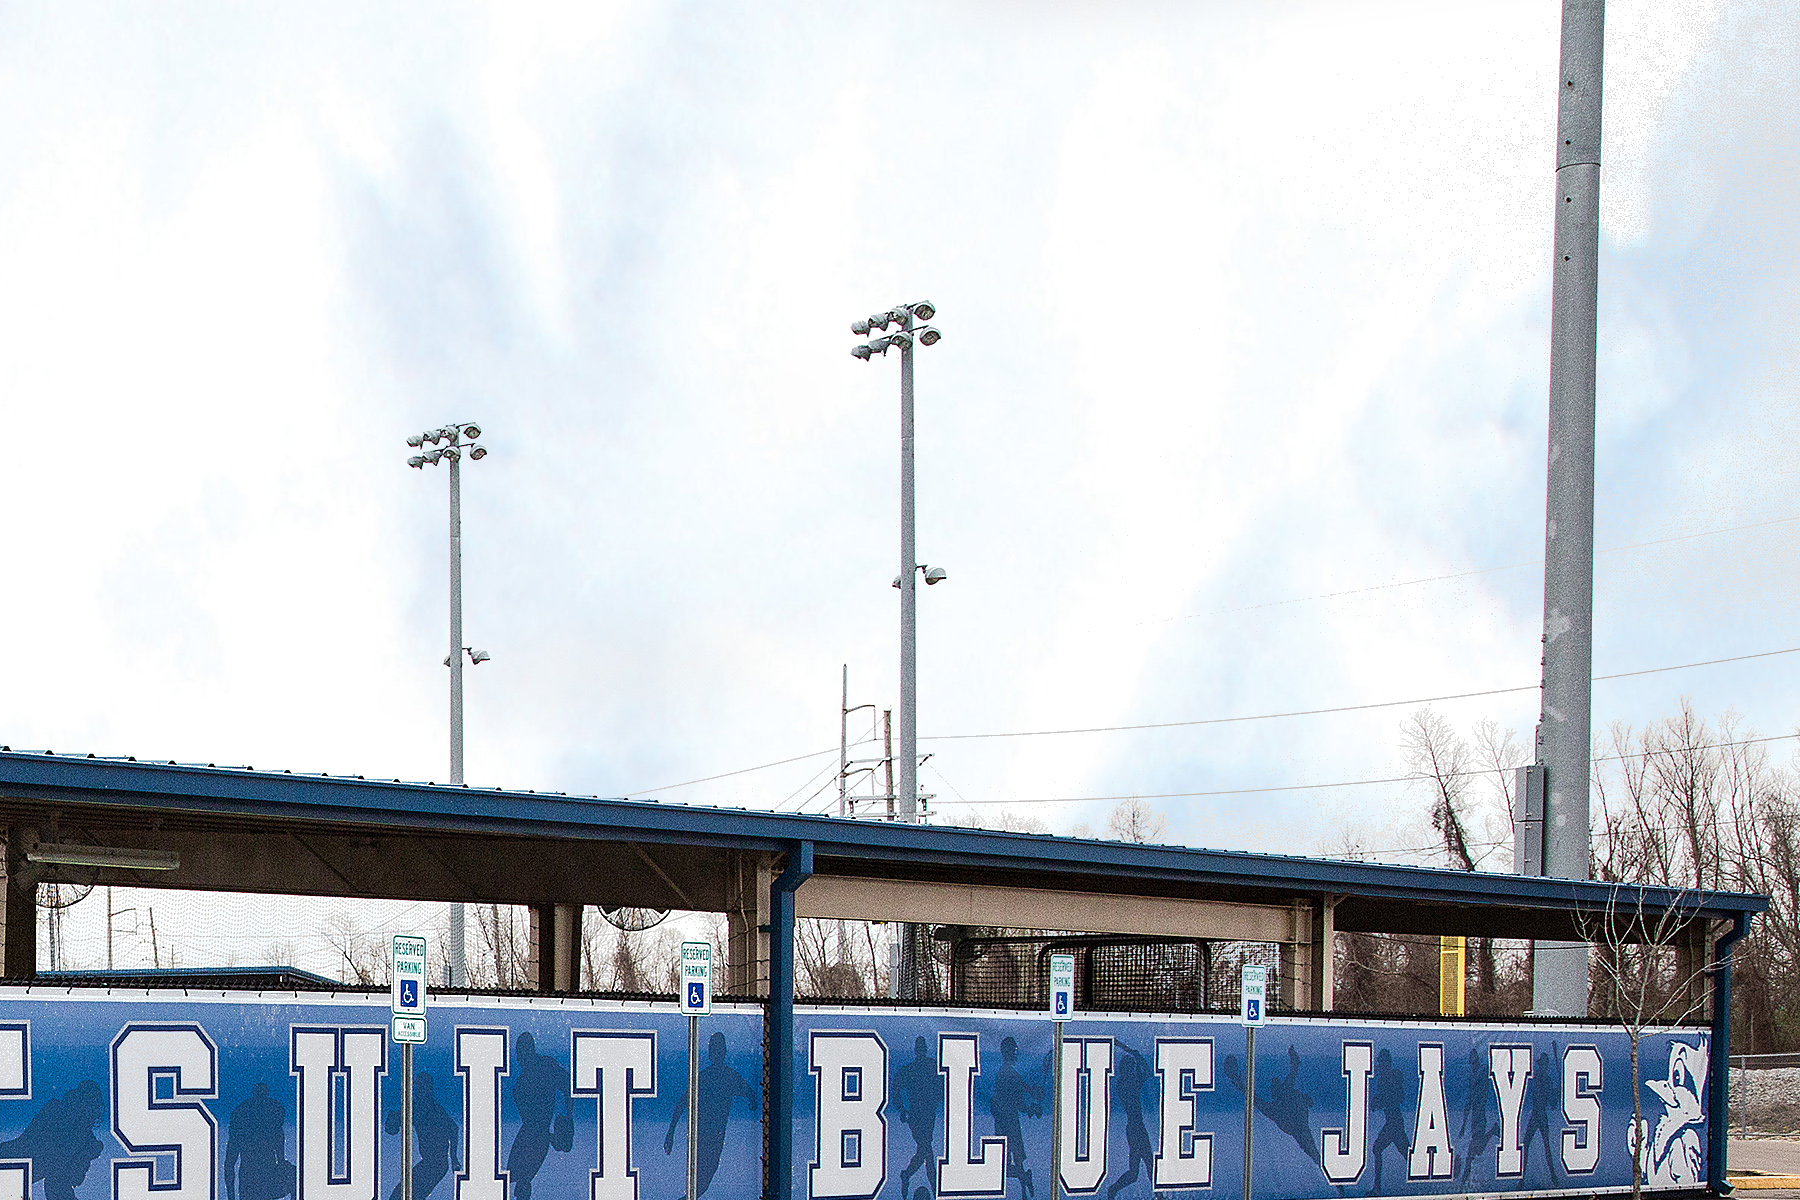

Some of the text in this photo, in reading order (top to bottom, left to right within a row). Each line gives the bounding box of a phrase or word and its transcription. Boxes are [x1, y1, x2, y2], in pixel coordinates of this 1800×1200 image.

[395, 942, 424, 957] RESERVED
[682, 948, 709, 961] RESERVED
[396, 961, 422, 974] PARKING
[685, 965, 708, 977] PARKING
[403, 1022, 416, 1030] VAN
[1320, 1039, 1603, 1186] JAYS
